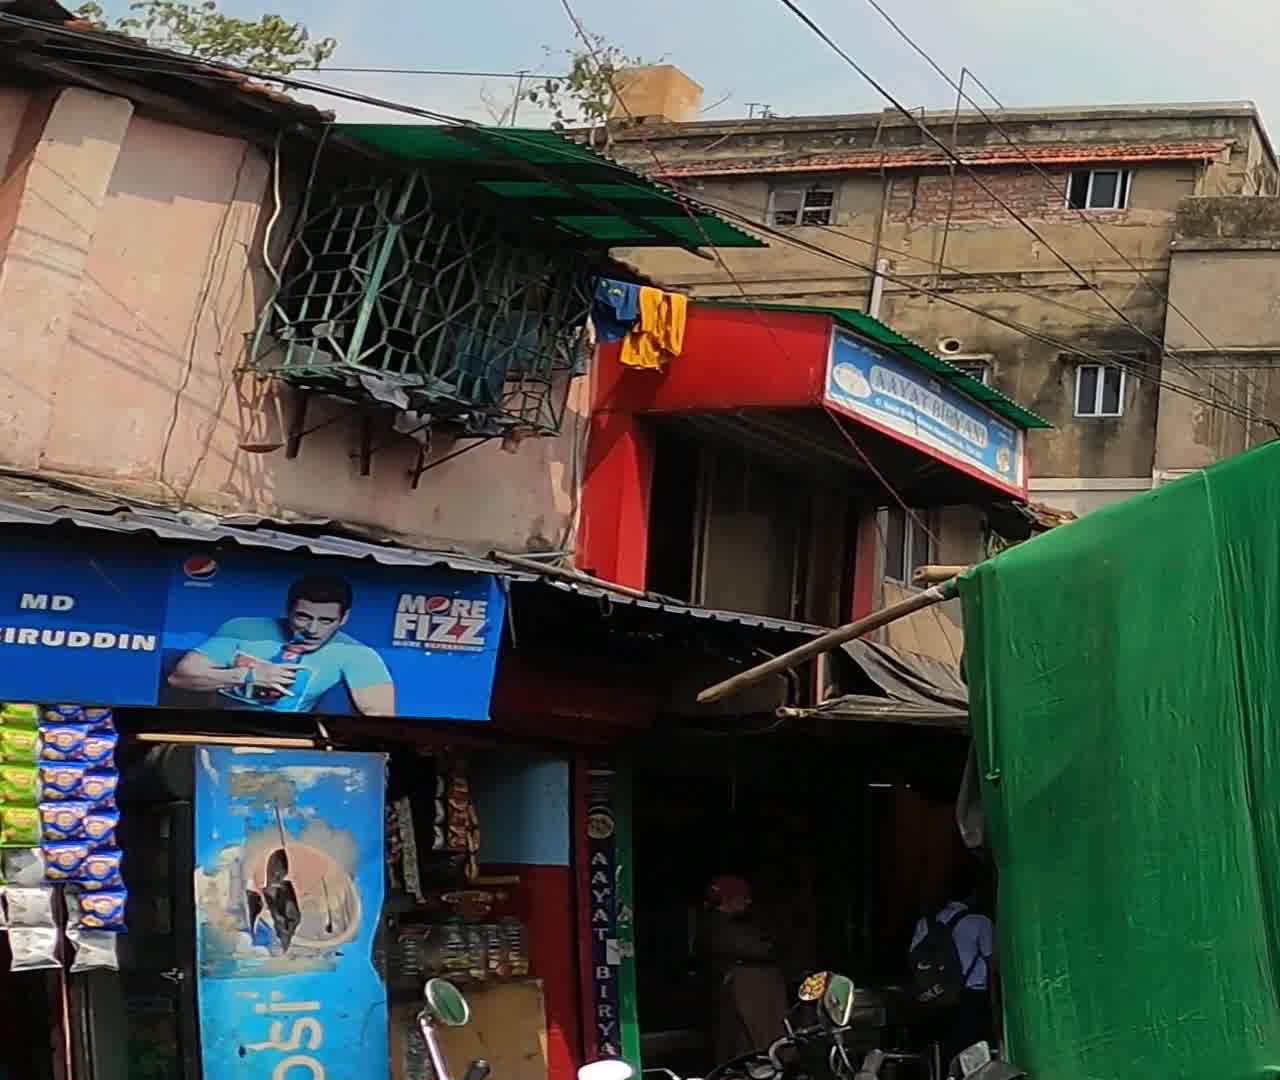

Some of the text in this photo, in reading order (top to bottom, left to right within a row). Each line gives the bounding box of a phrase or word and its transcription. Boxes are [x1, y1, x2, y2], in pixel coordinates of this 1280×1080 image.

[20, 593, 74, 611] MD
[393, 612, 486, 645] FIZZ
[591, 851, 610, 942] AAYAT
